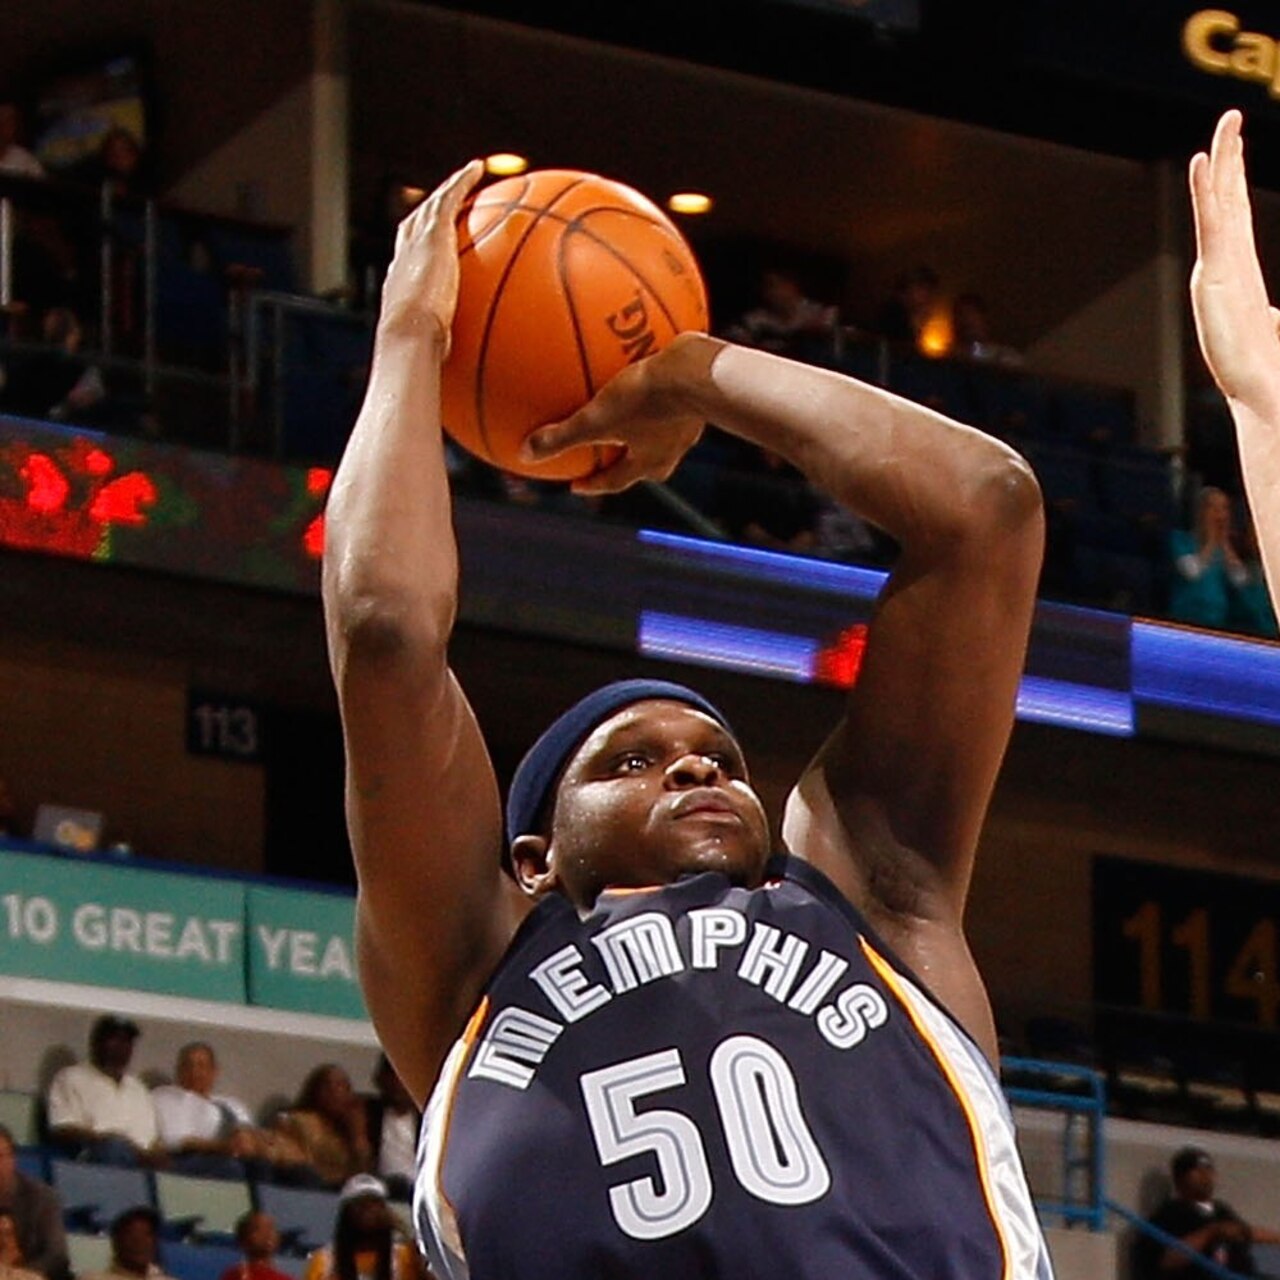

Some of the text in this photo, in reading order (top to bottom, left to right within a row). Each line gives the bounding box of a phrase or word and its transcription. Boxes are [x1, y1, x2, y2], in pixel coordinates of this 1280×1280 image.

[194, 704, 257, 753] 113
[2, 892, 58, 945] 10
[72, 902, 241, 964] GREAT
[468, 908, 888, 1089] MEMPHIS
[580, 1035, 831, 1240] 50
